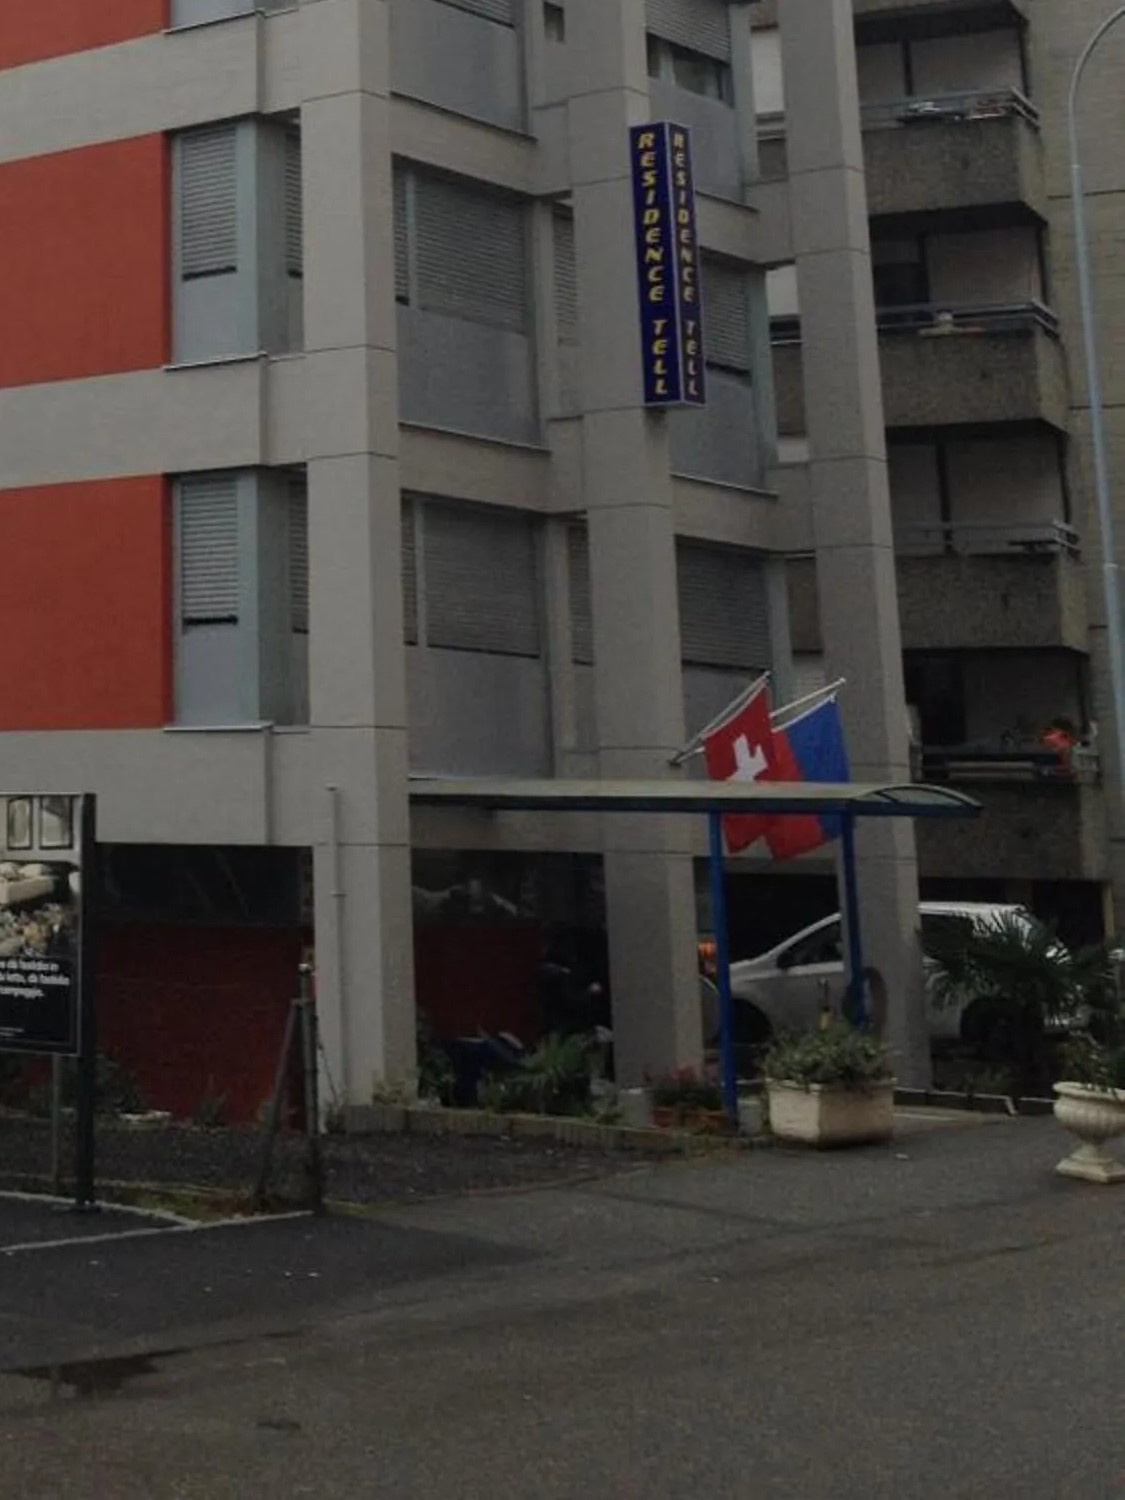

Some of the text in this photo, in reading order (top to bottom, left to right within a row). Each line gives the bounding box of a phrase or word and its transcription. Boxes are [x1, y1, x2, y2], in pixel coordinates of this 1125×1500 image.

[637, 131, 669, 395] RESIDENCE TELL
[673, 132, 699, 396] RESIDENCE TELL
